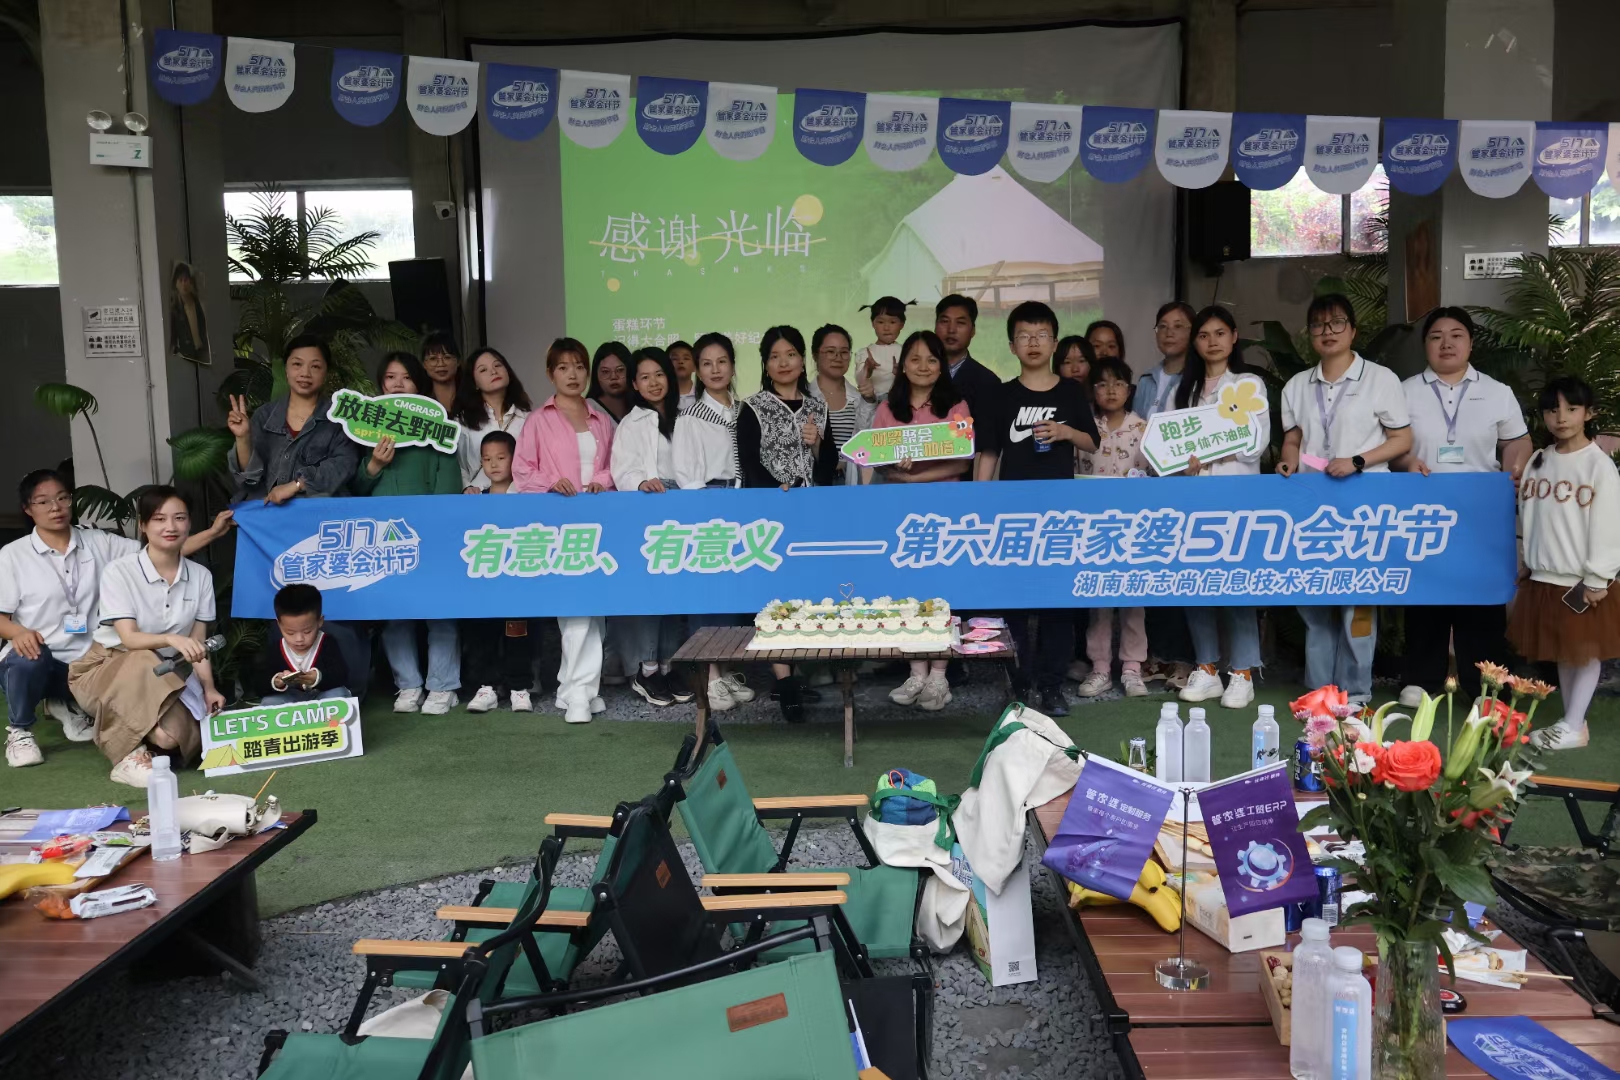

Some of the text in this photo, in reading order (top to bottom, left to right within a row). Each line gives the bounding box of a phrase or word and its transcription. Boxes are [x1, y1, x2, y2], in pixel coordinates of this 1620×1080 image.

[178, 47, 199, 57] 517
[250, 56, 271, 66] 517
[358, 66, 379, 77] 517
[434, 76, 454, 85] 517
[512, 82, 533, 92] 517
[585, 89, 605, 98] 517
[663, 94, 684, 104] 517
[732, 101, 752, 110] 517
[820, 106, 842, 116] 517
[892, 112, 913, 121] 517
[964, 115, 986, 125] 517
[1035, 121, 1056, 130] 517
[1108, 123, 1130, 133] 517
[1184, 128, 1205, 138] 517
[1259, 130, 1281, 140] 517
[1332, 133, 1354, 144] 517
[1410, 135, 1432, 145] 517
[1488, 137, 1509, 147] 517
[1560, 138, 1583, 148] 517
[600, 205, 811, 263] 感谢光临
[612, 317, 666, 332] 蛋糕环节
[393, 399, 442, 418] CMGRASP
[334, 395, 457, 448] 放肆去野吧
[1016, 406, 1058, 427] NIKE
[1159, 415, 1203, 442] 跑步
[1170, 424, 1253, 458] 让身体不油腻
[893, 440, 955, 460] 快乐加倍
[319, 519, 377, 551] 517
[281, 546, 419, 582] 管家婆会计节
[1072, 566, 1411, 598] 湖南新志尚信息技术有限公司
[213, 705, 341, 737] LET'S CAMP
[243, 729, 339, 759] 踏青出游季
